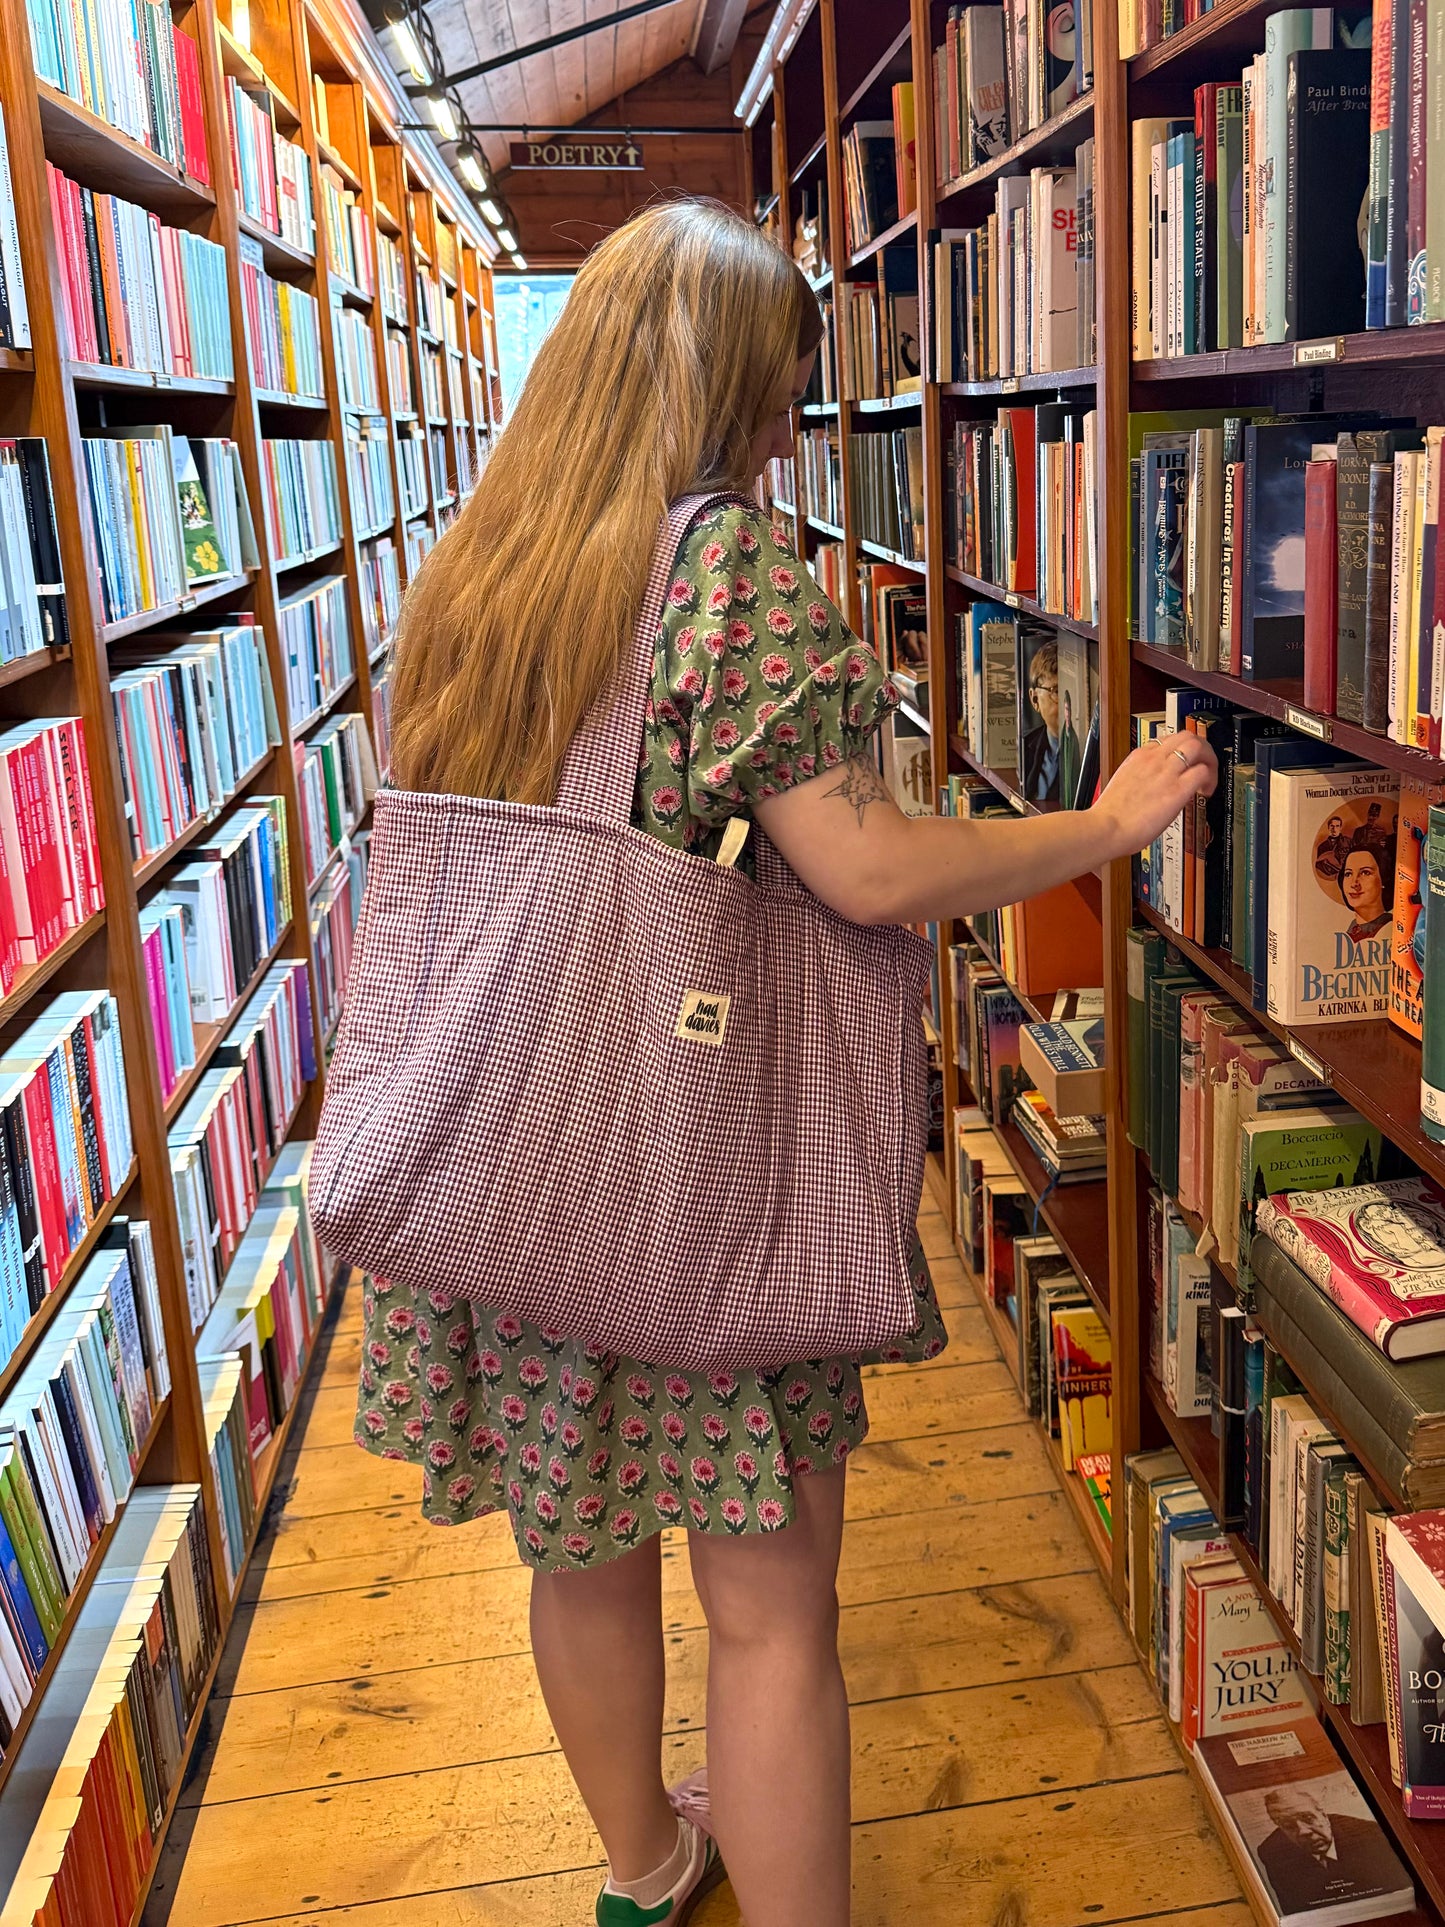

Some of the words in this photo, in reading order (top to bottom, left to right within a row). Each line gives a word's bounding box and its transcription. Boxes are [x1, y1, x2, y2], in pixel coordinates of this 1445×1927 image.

[1376, 19, 1391, 128] SEPARATE
[1308, 85, 1336, 97] Paul
[1305, 98, 1338, 112] After
[1342, 99, 1370, 111] Broc
[528, 144, 623, 166] POETRY
[1195, 174, 1204, 225] GOLDEN
[1195, 230, 1203, 277] SCALES
[13, 254, 22, 288] GALGUT
[1431, 266, 1440, 305] PICADOR
[1304, 350, 1314, 360] Paul
[1314, 348, 1331, 359] Binding
[1340, 455, 1369, 469] LORNA
[1338, 472, 1370, 486] DOONE
[1223, 463, 1235, 542] Creatures
[1223, 546, 1234, 564] in
[1223, 565, 1231, 576] a
[1222, 577, 1233, 630] dream
[986, 633, 1014, 646] Stephe
[986, 717, 1015, 727] WEST
[59, 731, 79, 832] SHELTER
[1305, 789, 1329, 799] Woman
[1330, 786, 1353, 797] Doctor's
[1354, 784, 1375, 795] Search
[1378, 783, 1386, 793] for
[1387, 783, 1400, 793] Love
[1352, 775, 1362, 784] The
[1363, 775, 1379, 785] Story
[1334, 932, 1392, 970] DARK
[1301, 965, 1391, 1002] BEGINNI
[1391, 960, 1412, 996] THE
[1318, 1001, 1367, 1017] KATRINKA
[1391, 992, 1401, 1014] IS
[685, 1012, 720, 1035] davies
[1028, 1024, 1044, 1037] OLD
[1051, 1055, 1070, 1071] TALE
[1050, 1040, 1066, 1051] THE
[1067, 1043, 1092, 1069] BENNETT
[1274, 1080, 1324, 1091] DECAME
[1281, 1130, 1344, 1146] Boccaccio
[1269, 1154, 1351, 1172] DECAMERON
[1290, 1194, 1315, 1207] THE
[1322, 1180, 1420, 1201] PENTAMERON
[8, 1215, 17, 1247] MARK
[0, 1230, 9, 1262] MARK
[12, 1247, 22, 1293] HADDON
[1425, 1277, 1445, 1288] RIC
[3, 1264, 14, 1310] HADDON
[1064, 1380, 1111, 1393] INHERI
[1306, 1506, 1318, 1532] The
[1296, 1530, 1305, 1588] ADAM
[1235, 1592, 1257, 1602] NOV
[1386, 1563, 1395, 1607] GUEST
[1214, 1604, 1250, 1623] Mary
[1304, 1607, 1316, 1639] Time
[1374, 1526, 1387, 1621] AMBASSADOR
[1382, 1625, 1396, 1741] EXTRAORDINARY
[1389, 1609, 1398, 1655] ROOM
[1280, 1652, 1300, 1674] th
[1211, 1679, 1285, 1719] JURY
[1396, 1706, 1404, 1774] BOHJALIAN
